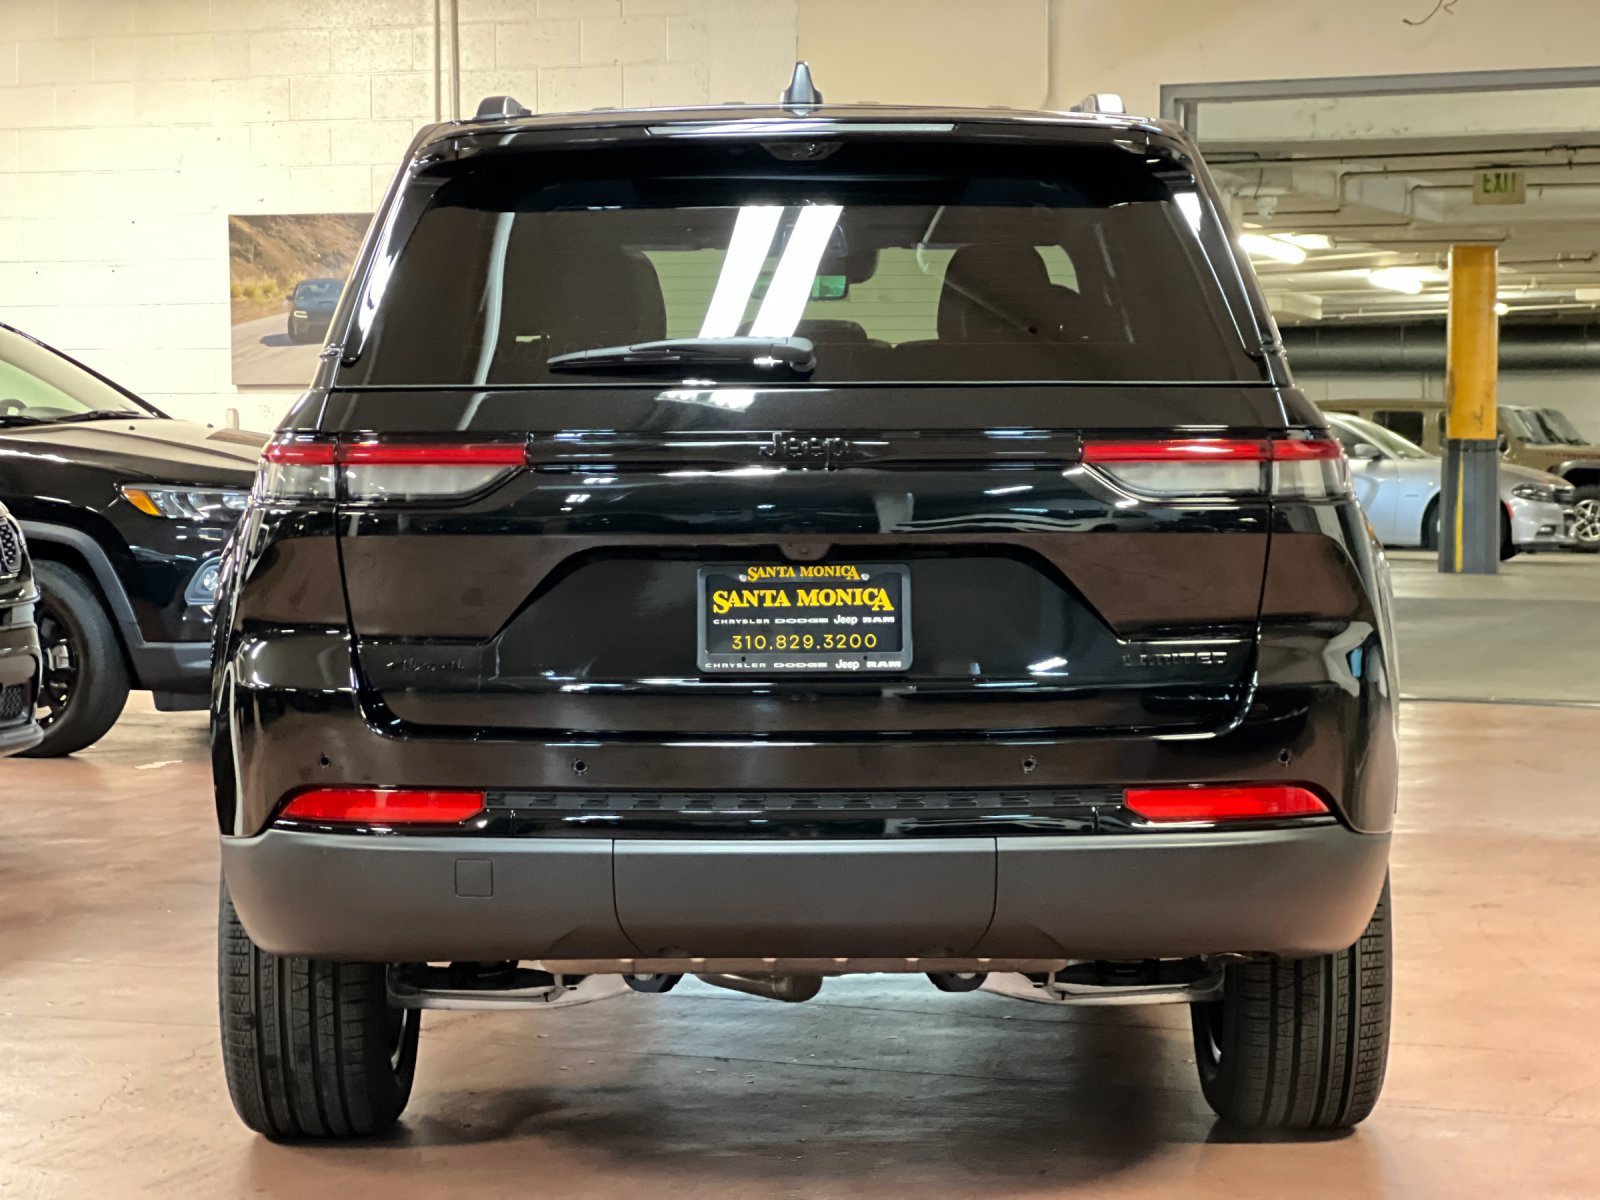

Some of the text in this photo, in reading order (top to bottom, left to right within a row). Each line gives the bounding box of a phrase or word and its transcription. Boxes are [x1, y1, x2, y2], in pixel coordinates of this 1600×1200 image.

[759, 431, 850, 471] Jeep
[747, 565, 861, 582] SANTA MONICA
[713, 587, 895, 614] SANTA MONICA
[774, 617, 829, 625] DODGE
[833, 614, 858, 627] Jeep
[862, 616, 895, 624] RAM
[731, 633, 877, 650] 310.829.3200
[773, 661, 828, 669] DODGE
[835, 659, 860, 671] Jeep
[866, 660, 902, 668] RAM
